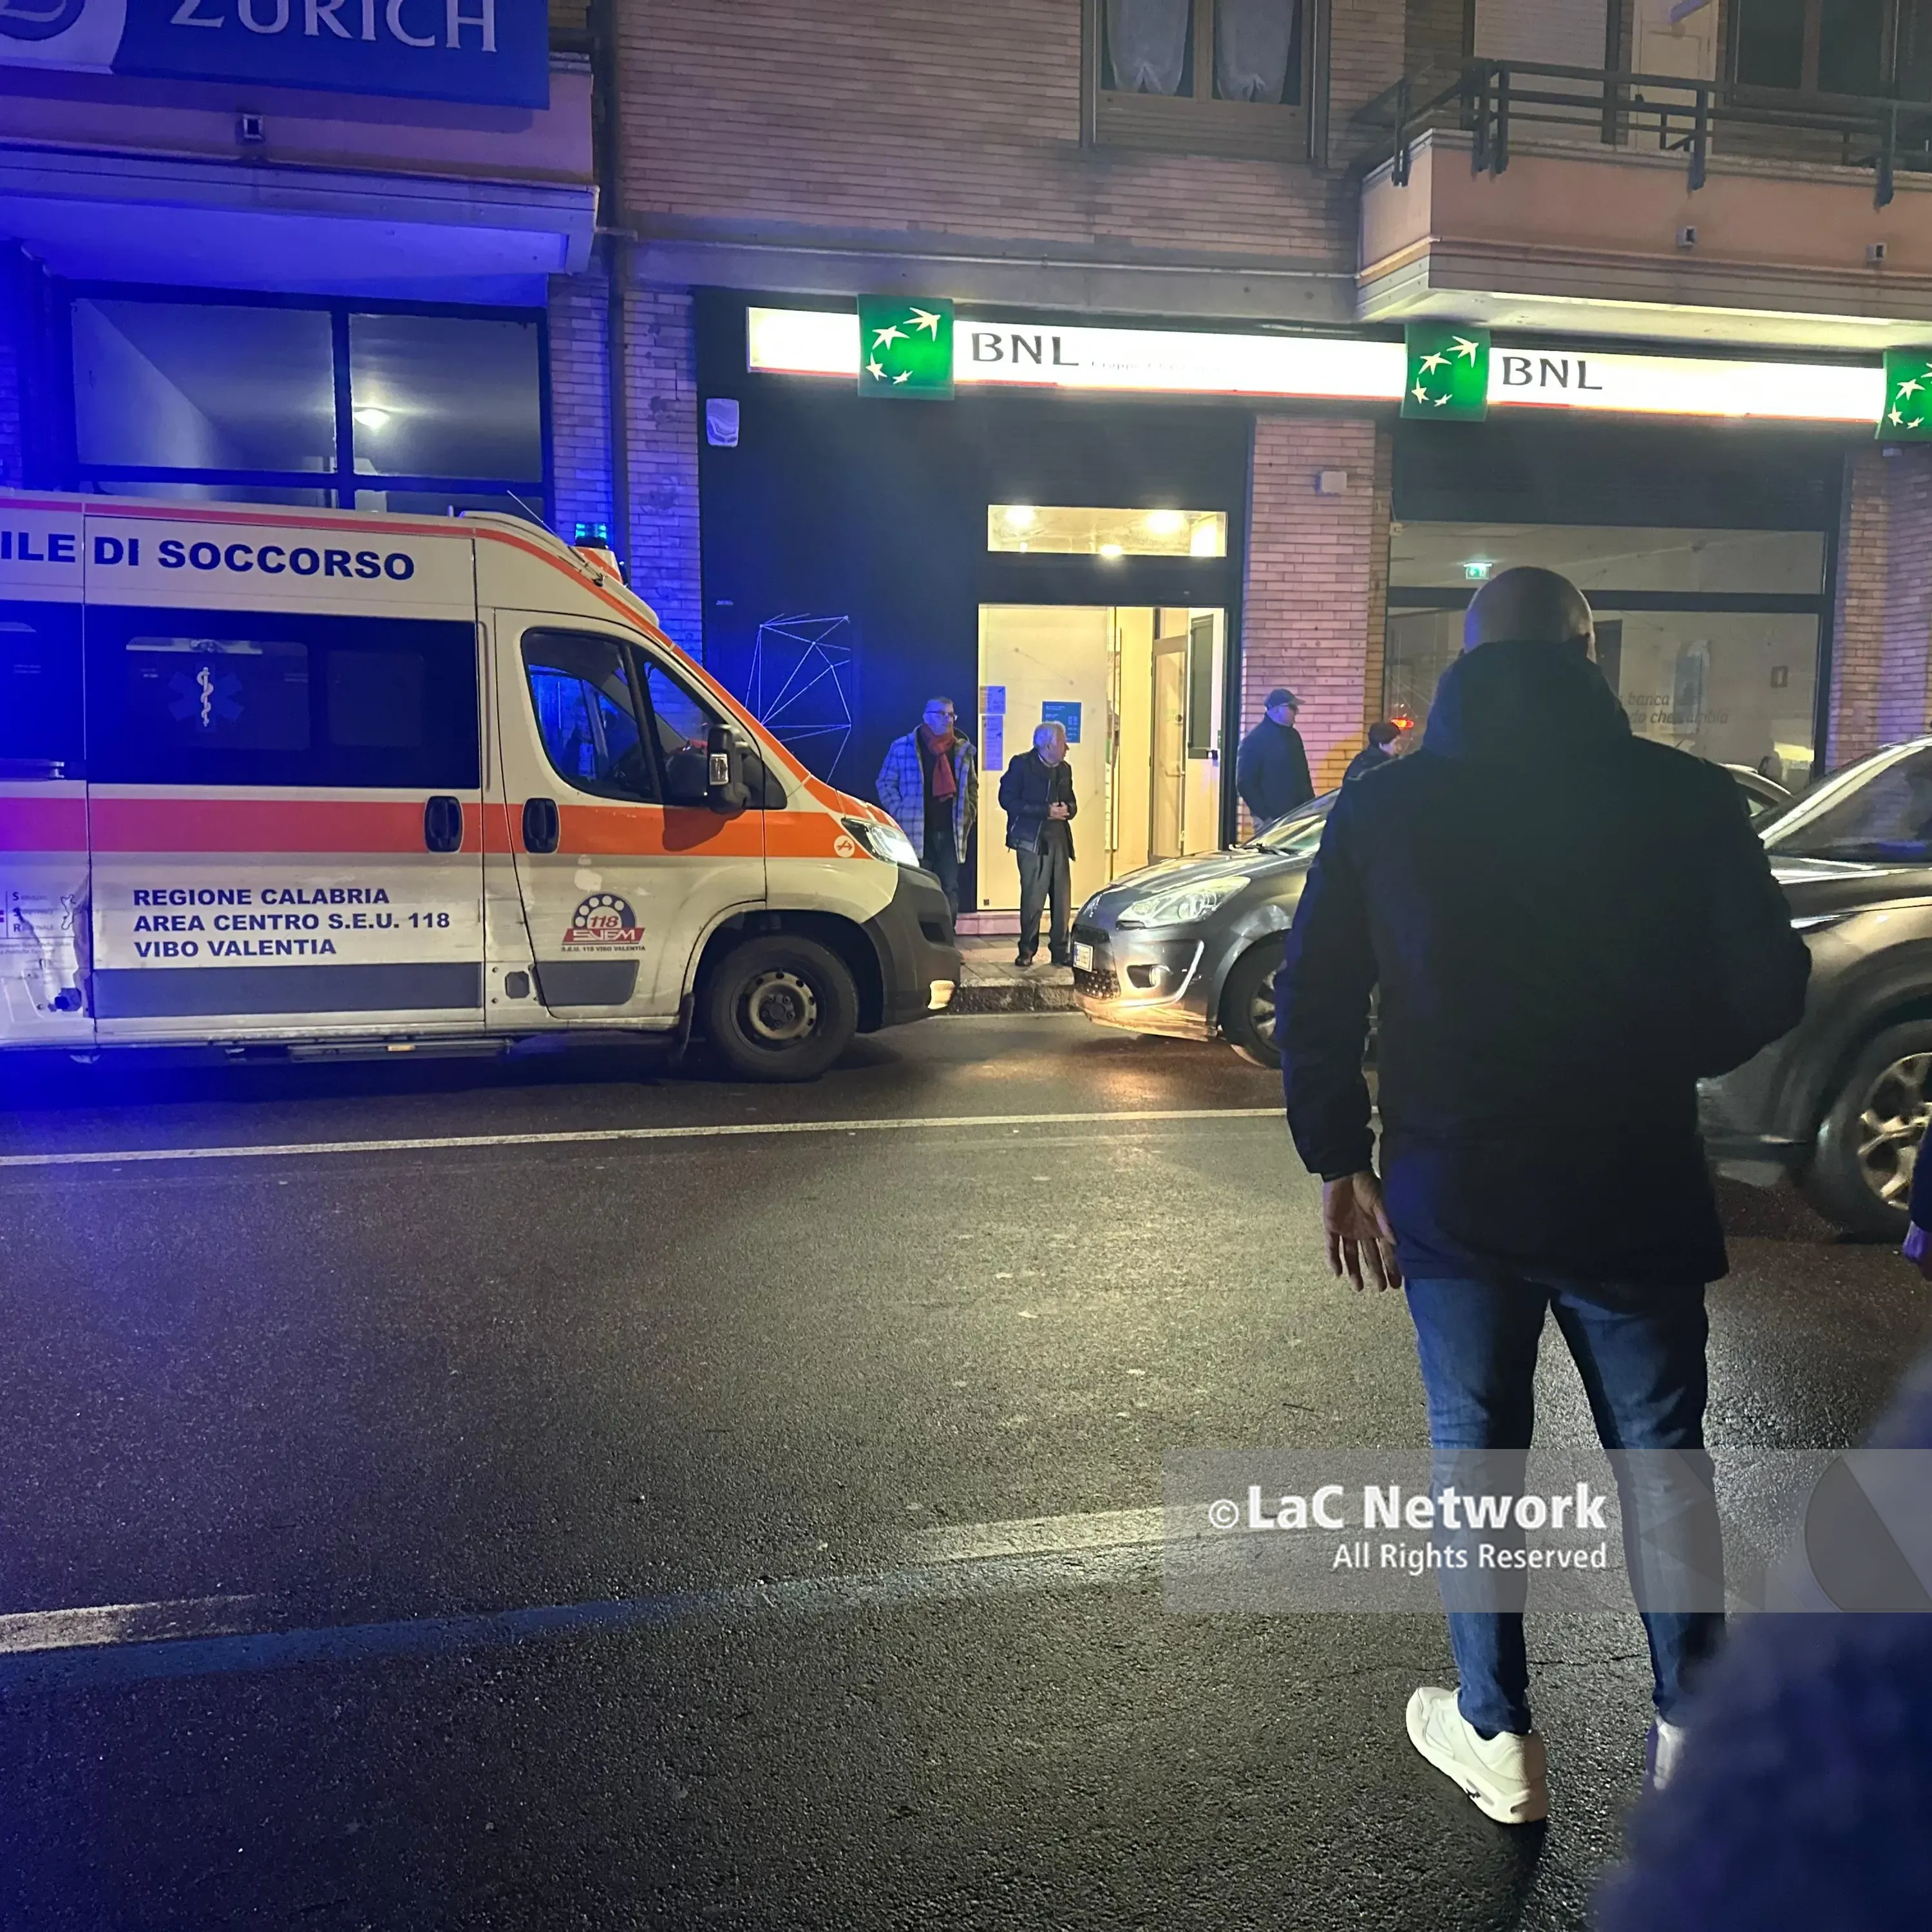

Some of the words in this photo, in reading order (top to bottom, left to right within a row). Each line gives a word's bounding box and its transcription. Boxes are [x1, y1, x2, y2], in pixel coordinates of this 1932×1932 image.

[971, 333, 1079, 366] BNL
[1502, 357, 1602, 390] BNL
[93, 536, 140, 566] DI
[158, 540, 415, 580] SOCCORSO
[1678, 709, 1728, 724] ambia
[133, 889, 252, 905] REGIONE
[261, 888, 390, 905] CALABRIA
[133, 915, 205, 931] AREA
[214, 914, 319, 931] CENTRO
[328, 913, 399, 929] S.E.U.
[408, 912, 450, 929] 118
[590, 916, 619, 927] 118
[134, 941, 199, 958] VIBO
[208, 939, 337, 956] VALENTIA
